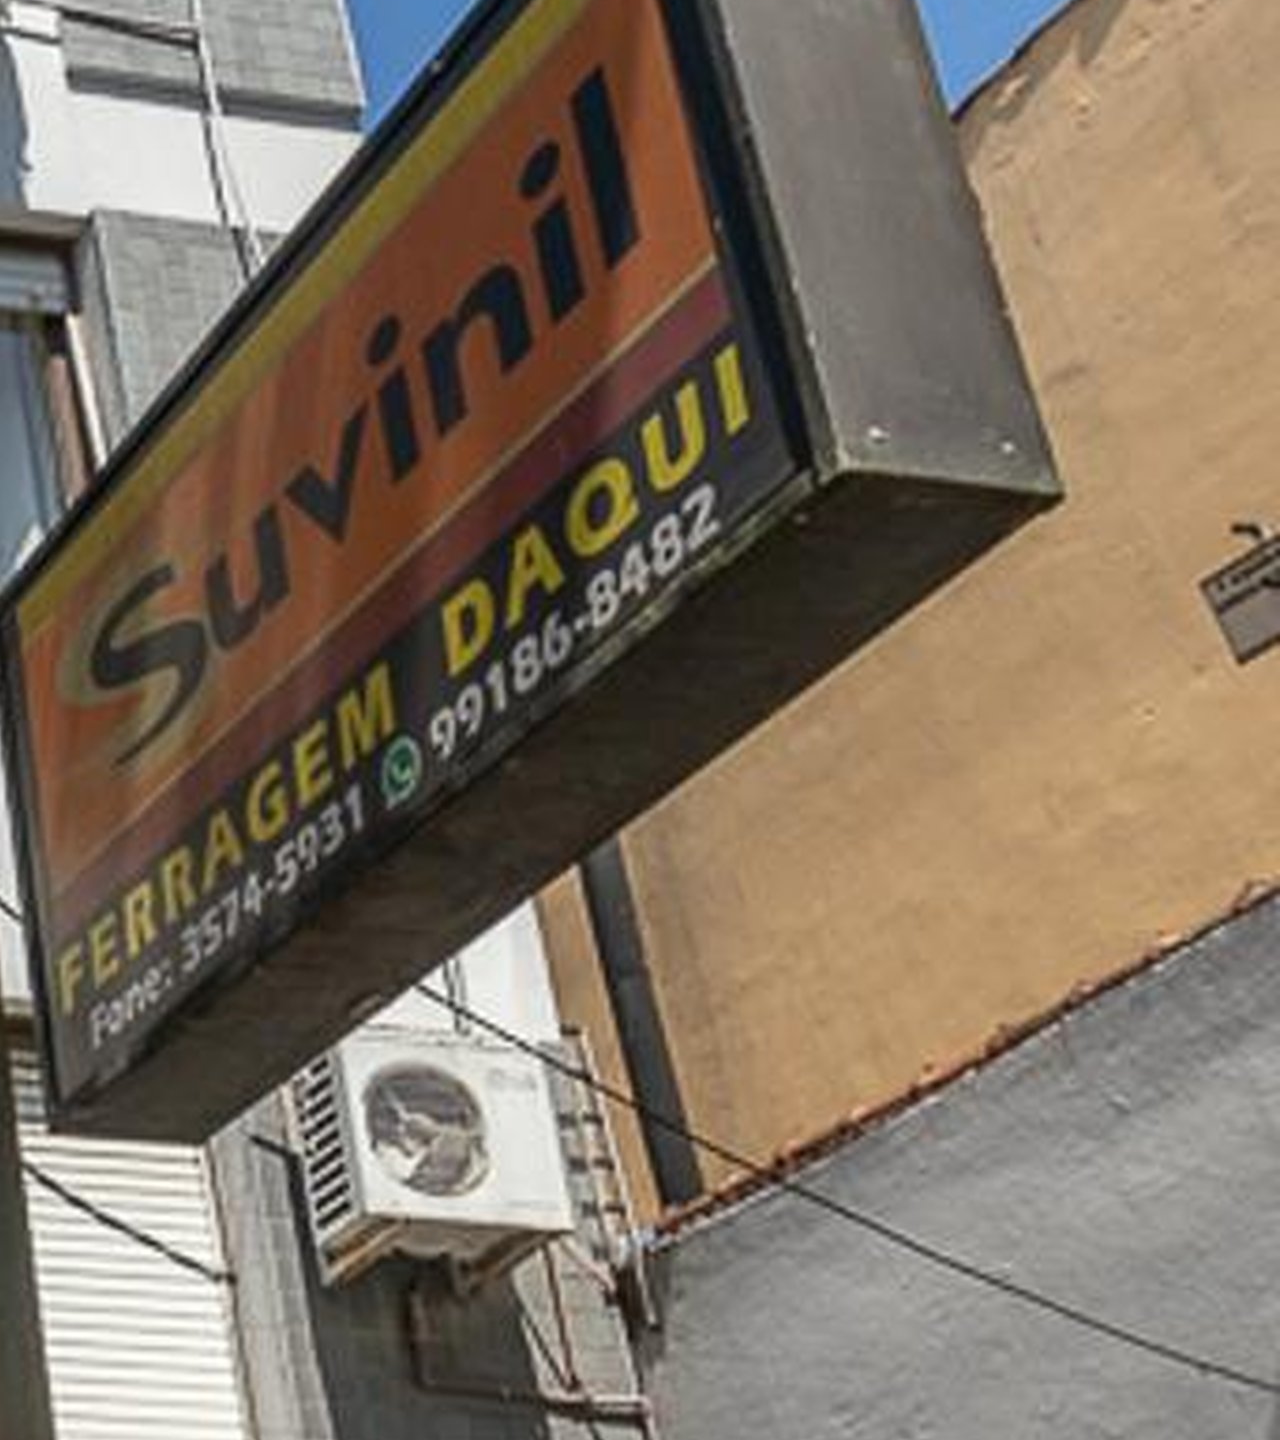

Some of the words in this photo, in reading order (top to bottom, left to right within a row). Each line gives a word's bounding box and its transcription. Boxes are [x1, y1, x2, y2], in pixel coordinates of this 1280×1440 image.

[56, 661, 398, 1017] FERRAGEM
[441, 342, 750, 677] DAQUI
[80, 64, 640, 774] Suvinil
[89, 962, 174, 1049] Fone:
[180, 785, 364, 972] 3574-5931
[429, 483, 721, 761] 99186-8482
